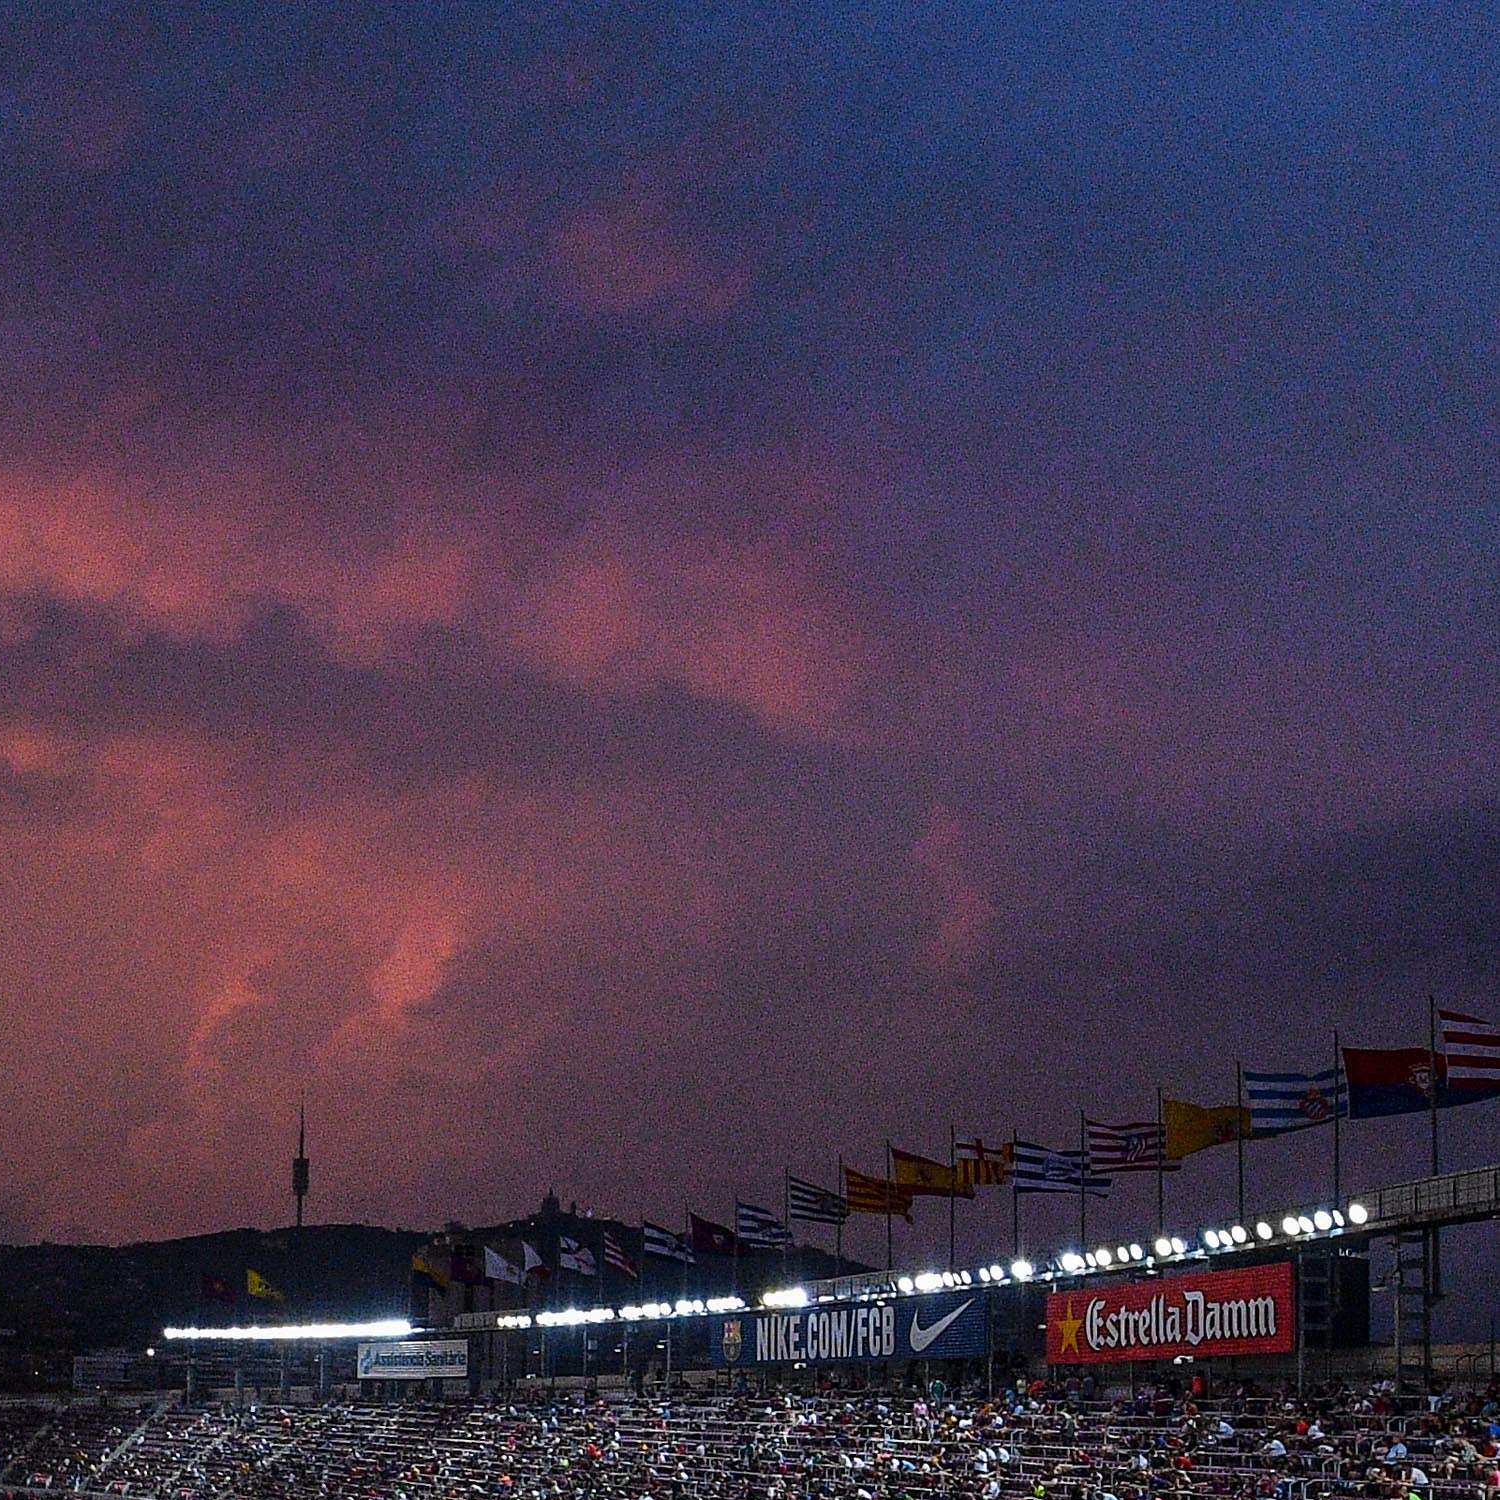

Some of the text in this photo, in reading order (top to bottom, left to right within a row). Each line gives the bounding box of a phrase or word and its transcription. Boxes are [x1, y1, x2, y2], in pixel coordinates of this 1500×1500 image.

[756, 1306, 895, 1362] NIKE.COM/FCB
[1085, 1290, 1277, 1351] Estrella Damm
